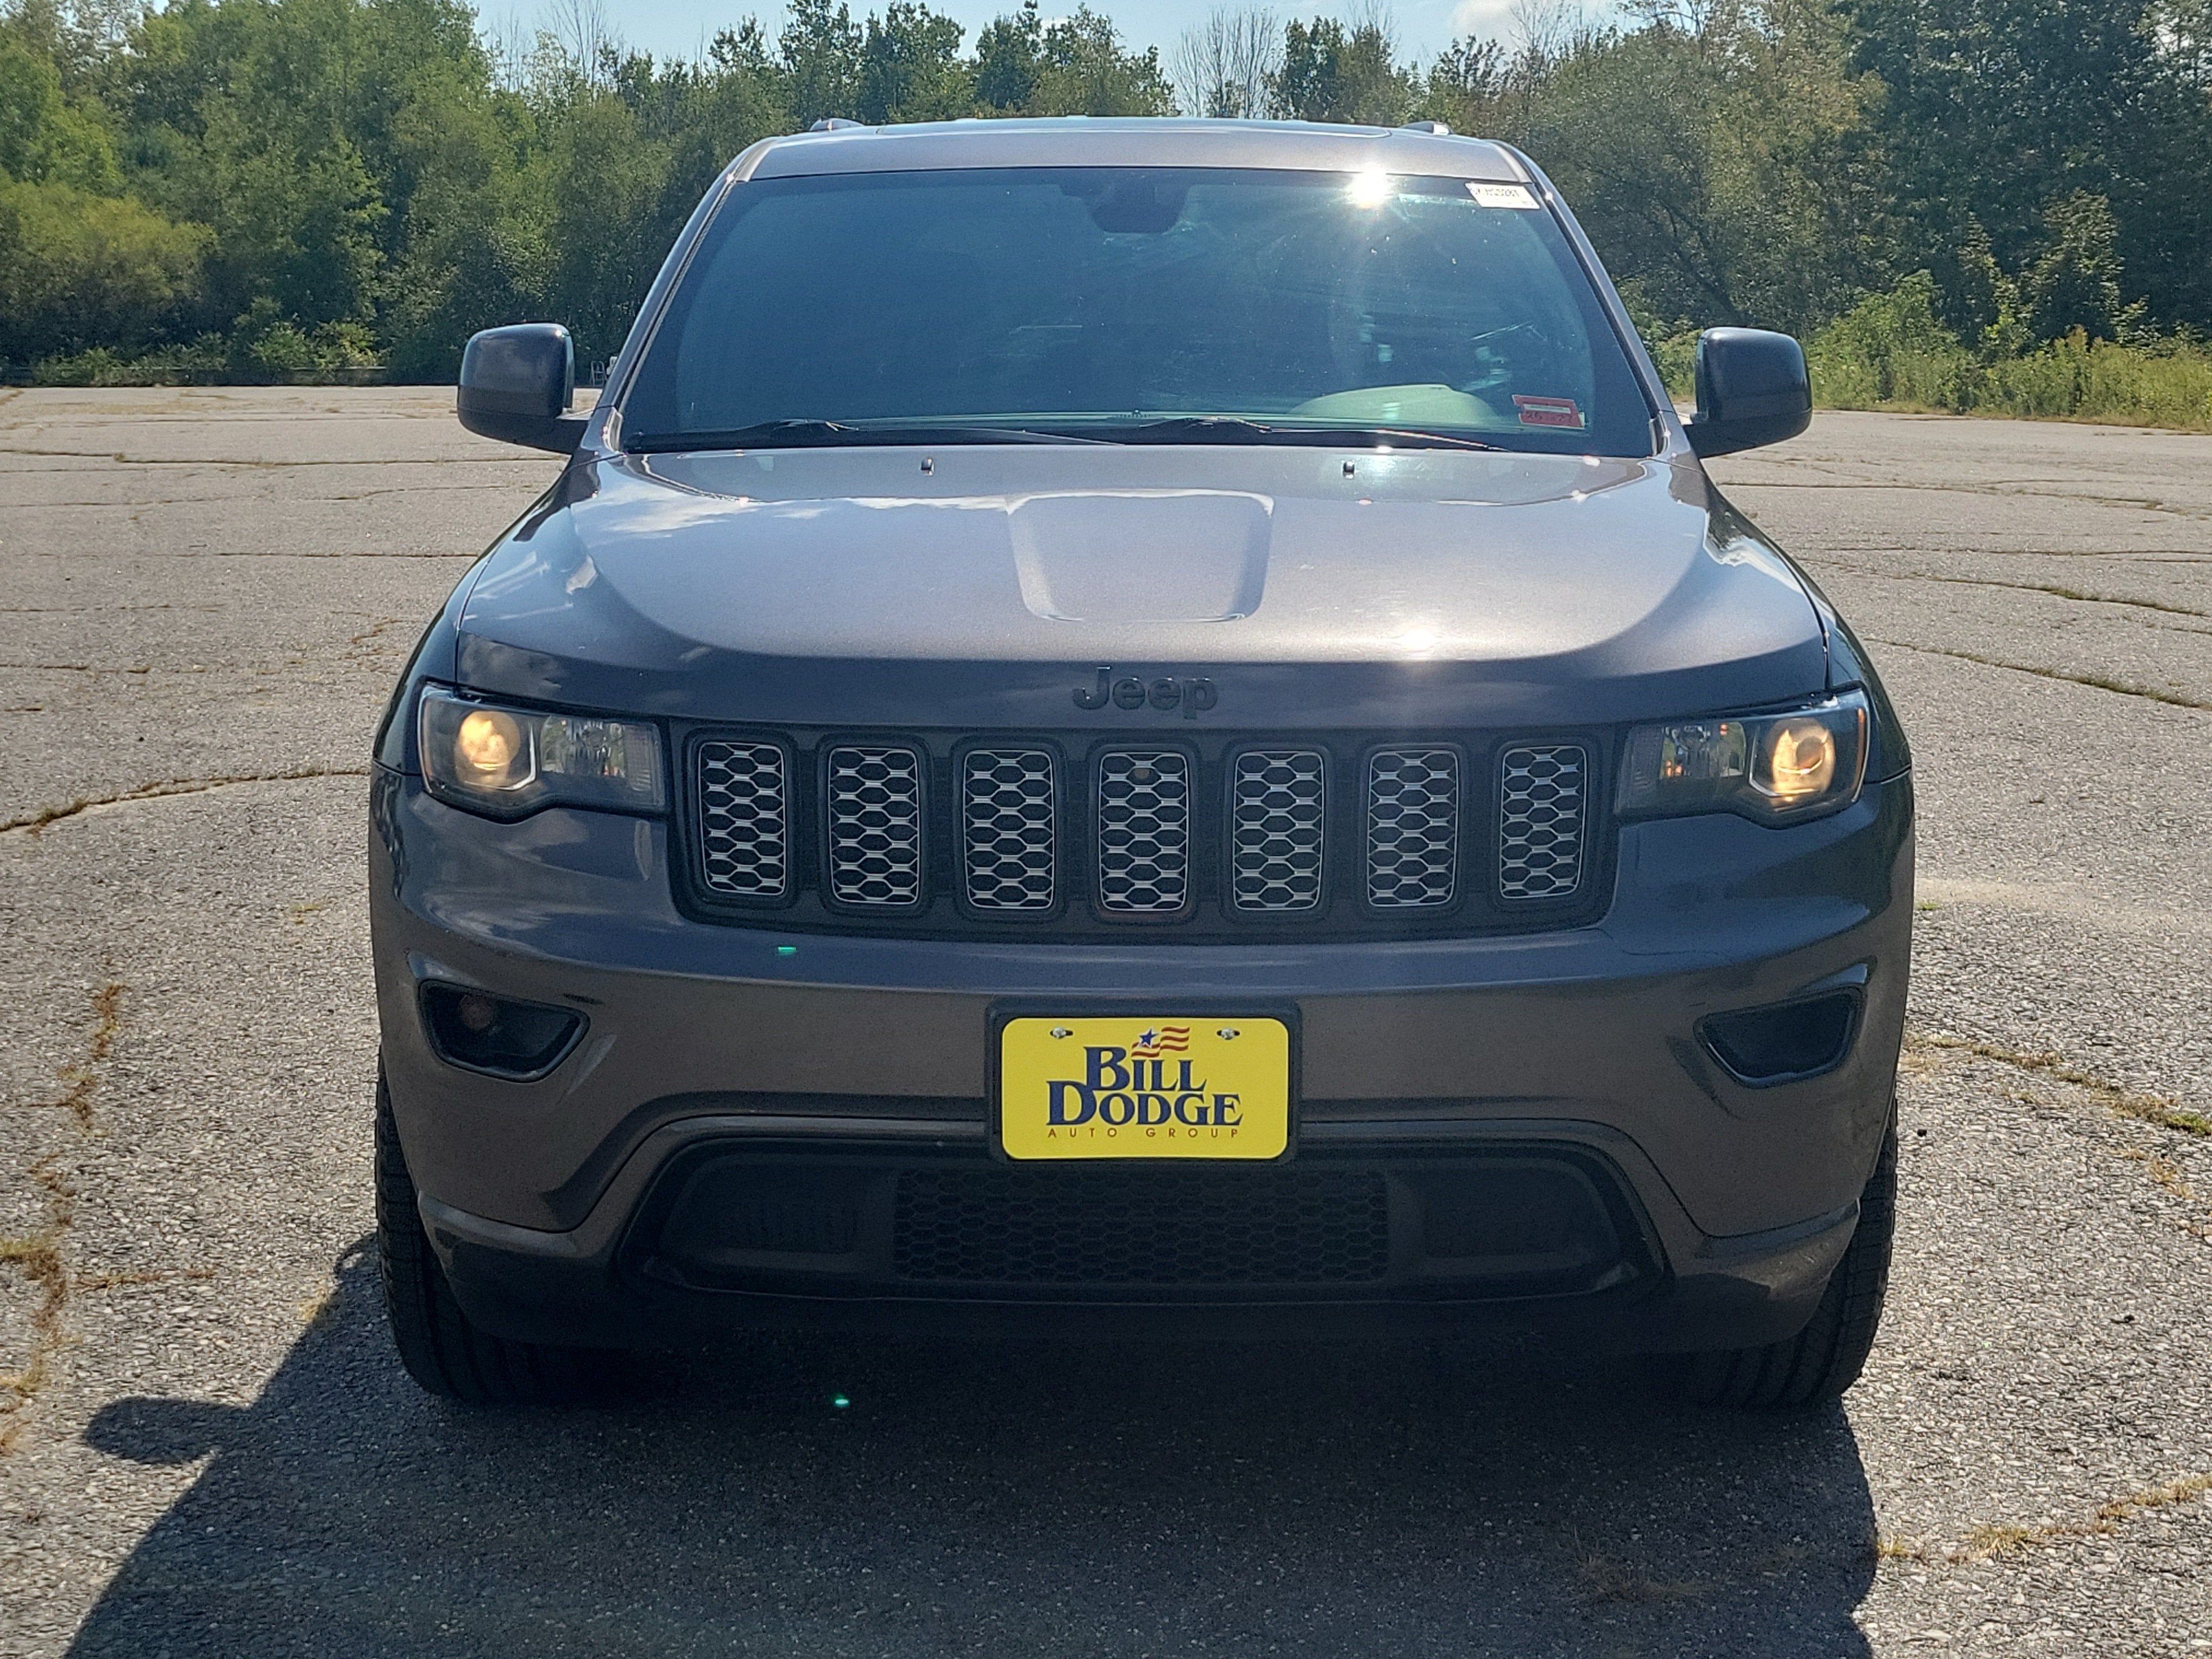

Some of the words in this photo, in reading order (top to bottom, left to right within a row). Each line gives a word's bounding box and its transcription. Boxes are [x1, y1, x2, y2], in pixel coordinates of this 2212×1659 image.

[1072, 665, 1218, 719] Jeep
[1083, 1046, 1207, 1092] BILL
[1046, 1080, 1243, 1126] DODGE
[1047, 1128, 1117, 1138] AUTO
[1146, 1128, 1238, 1138] GROUP
